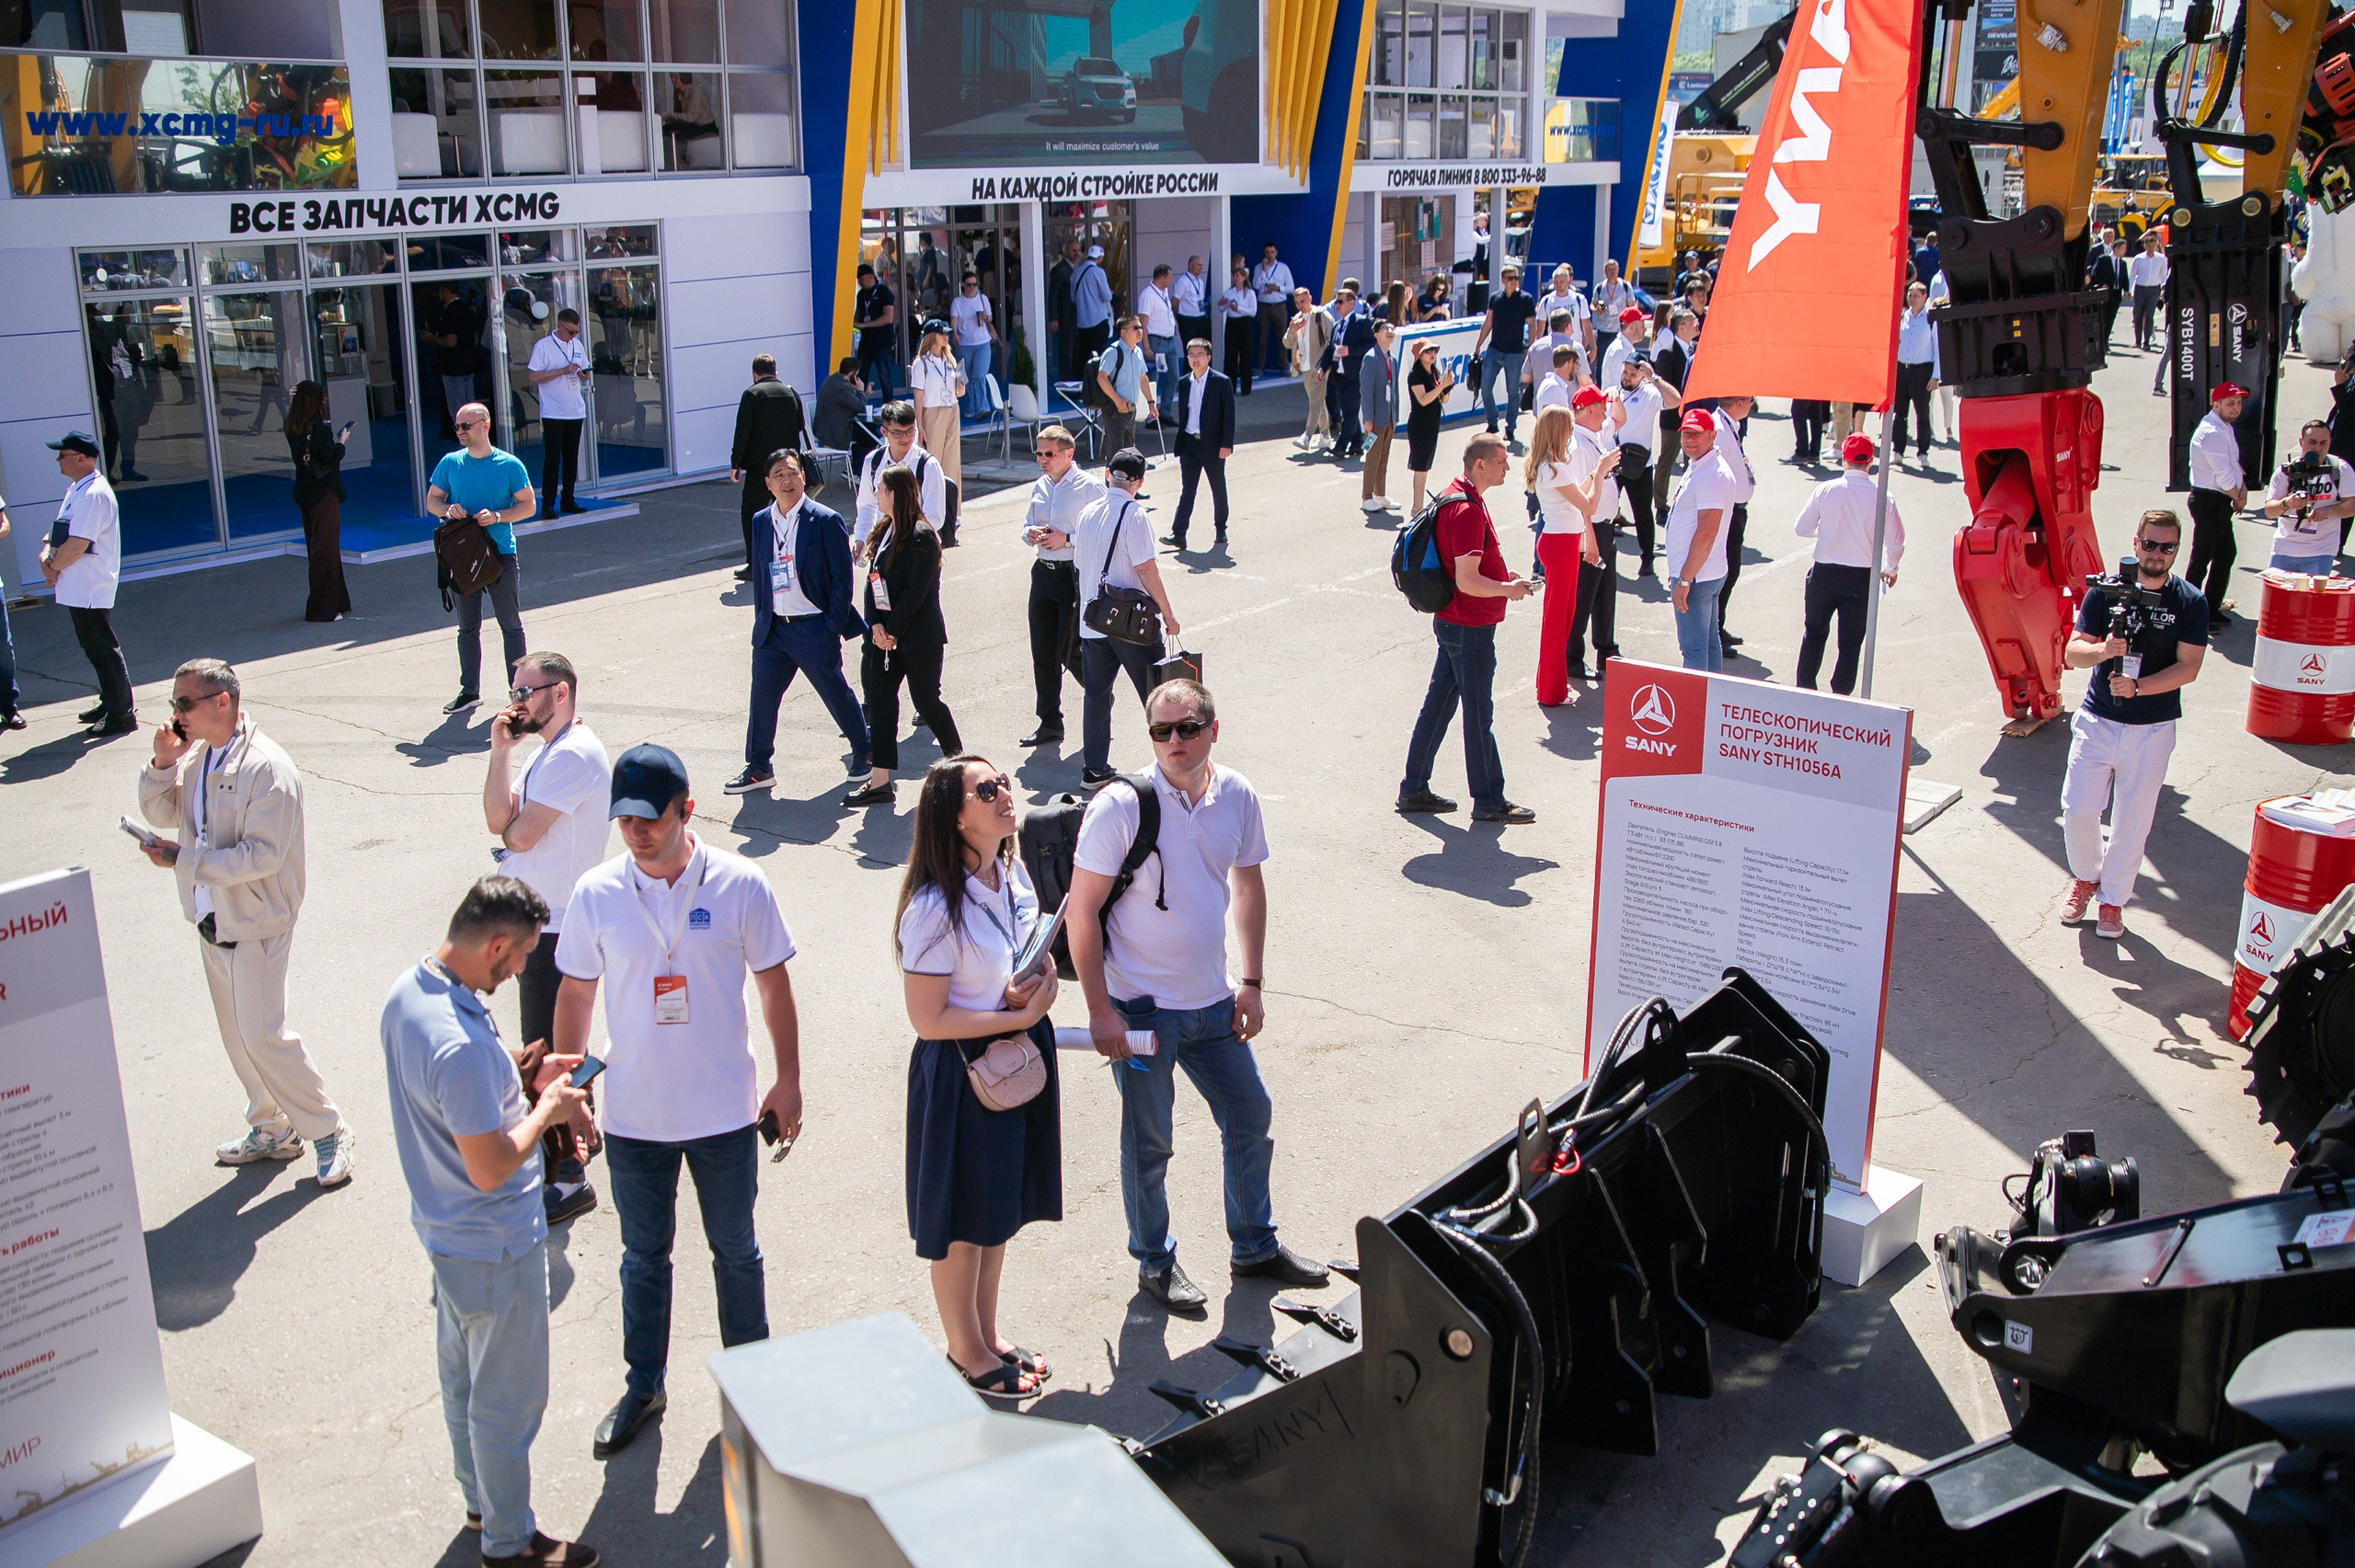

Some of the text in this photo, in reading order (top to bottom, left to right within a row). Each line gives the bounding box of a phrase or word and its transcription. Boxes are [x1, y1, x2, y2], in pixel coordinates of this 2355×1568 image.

[26, 111, 333, 145] www.xcmg-ru.ru
[1045, 140, 1160, 151] It will maximize customer's value
[971, 171, 1219, 201] НА КАЖДОЙ СТРОЙКЕ РОССИИ
[1387, 166, 1546, 188] ГОРЯЧАЯ ЛИНИЯ 8 800 333-96-88
[230, 191, 560, 234] ВСЕ ЗАПЧАСТИ XCMG
[2181, 307, 2194, 382] SYB1400T
[2233, 326, 2243, 363] SANY
[2056, 449, 2071, 463] SANY
[2297, 677, 2326, 686] SANY
[1720, 723, 1819, 754] ПОГРУЗНИК
[1721, 704, 1891, 748] ТЕЛЕСКОПИЧЕСКИЙ
[1626, 736, 1677, 757] SANY
[1719, 743, 1841, 779] SANY STH1056A
[1629, 799, 1755, 833] Технические характеристики
[2246, 944, 2275, 963] SANY
[11, 1227, 60, 1255] работы
